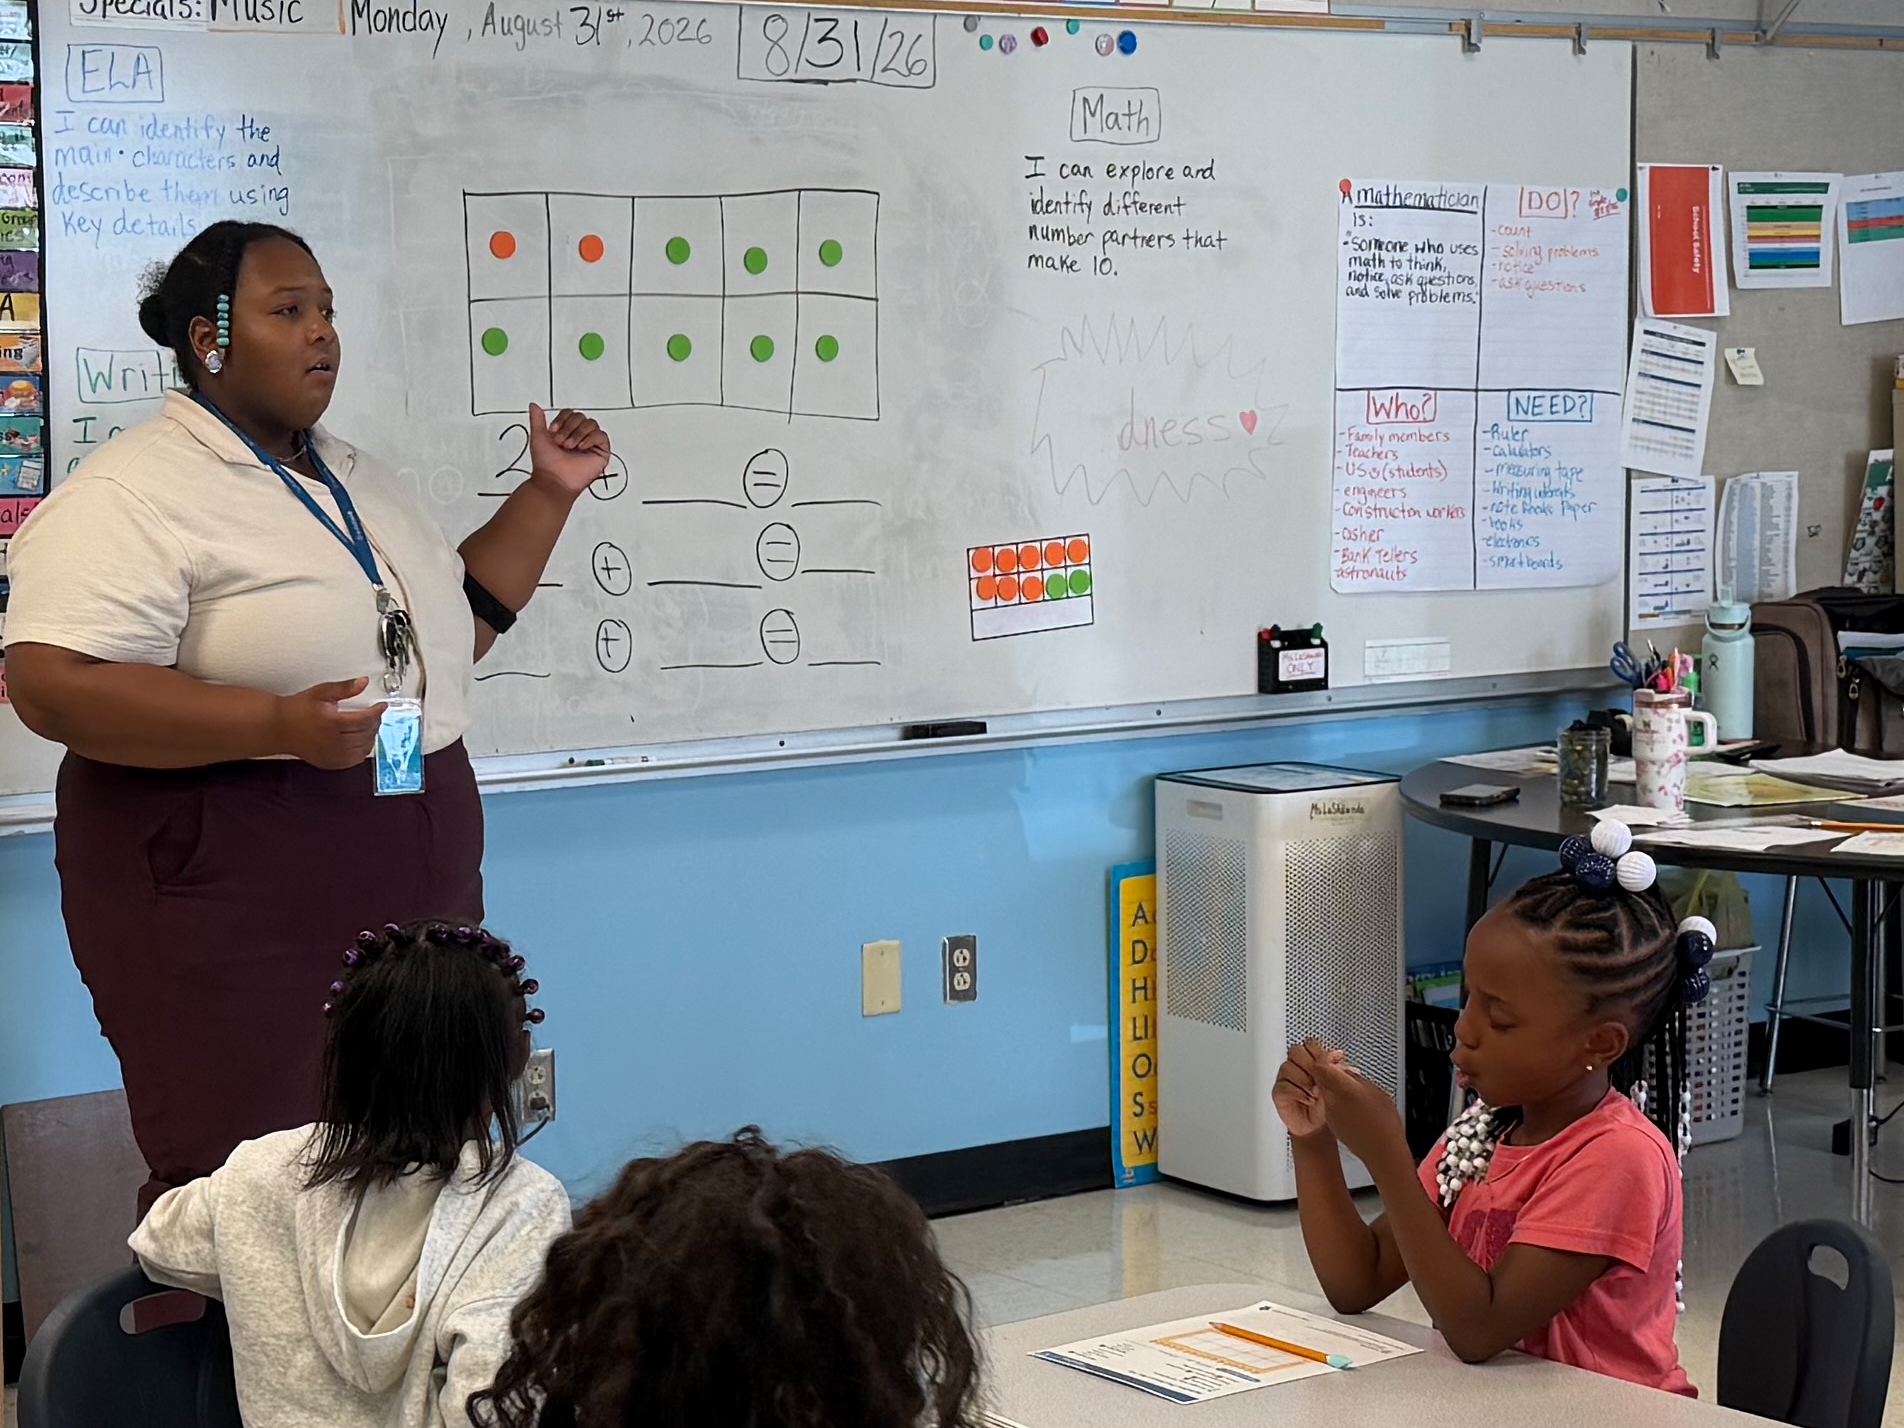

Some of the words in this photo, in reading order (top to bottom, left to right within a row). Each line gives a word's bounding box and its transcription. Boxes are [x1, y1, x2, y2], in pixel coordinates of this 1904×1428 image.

[483, 11, 561, 52] August
[571, 6, 624, 47] 31st
[764, 16, 928, 79] 8/31/26
[82, 50, 152, 92] ELA
[1083, 94, 1149, 136] Math
[140, 118, 225, 147] identify
[237, 114, 271, 142] the
[55, 148, 112, 168] main
[133, 147, 236, 169] characters
[248, 149, 279, 176] and
[1025, 156, 1045, 179] I
[1059, 163, 1093, 180] can
[1106, 161, 1174, 188] explore
[1183, 159, 1215, 180] and
[53, 177, 150, 206] describe
[230, 187, 289, 216] using
[1030, 186, 1092, 223] identify
[1103, 193, 1186, 216] different
[1353, 213, 1373, 227] is:
[1498, 226, 1533, 238] count
[1028, 225, 1094, 245] number
[1102, 229, 1175, 254] partners
[1183, 229, 1227, 250] that
[1415, 239, 1443, 254] who
[1450, 244, 1479, 256] uses
[1349, 256, 1385, 268] math
[1390, 258, 1403, 270] to
[1373, 392, 1432, 421] Who?
[1515, 394, 1587, 419] NEED?
[1347, 428, 1384, 446] Family
[1389, 431, 1449, 442] members
[1347, 445, 1398, 460] Teachers
